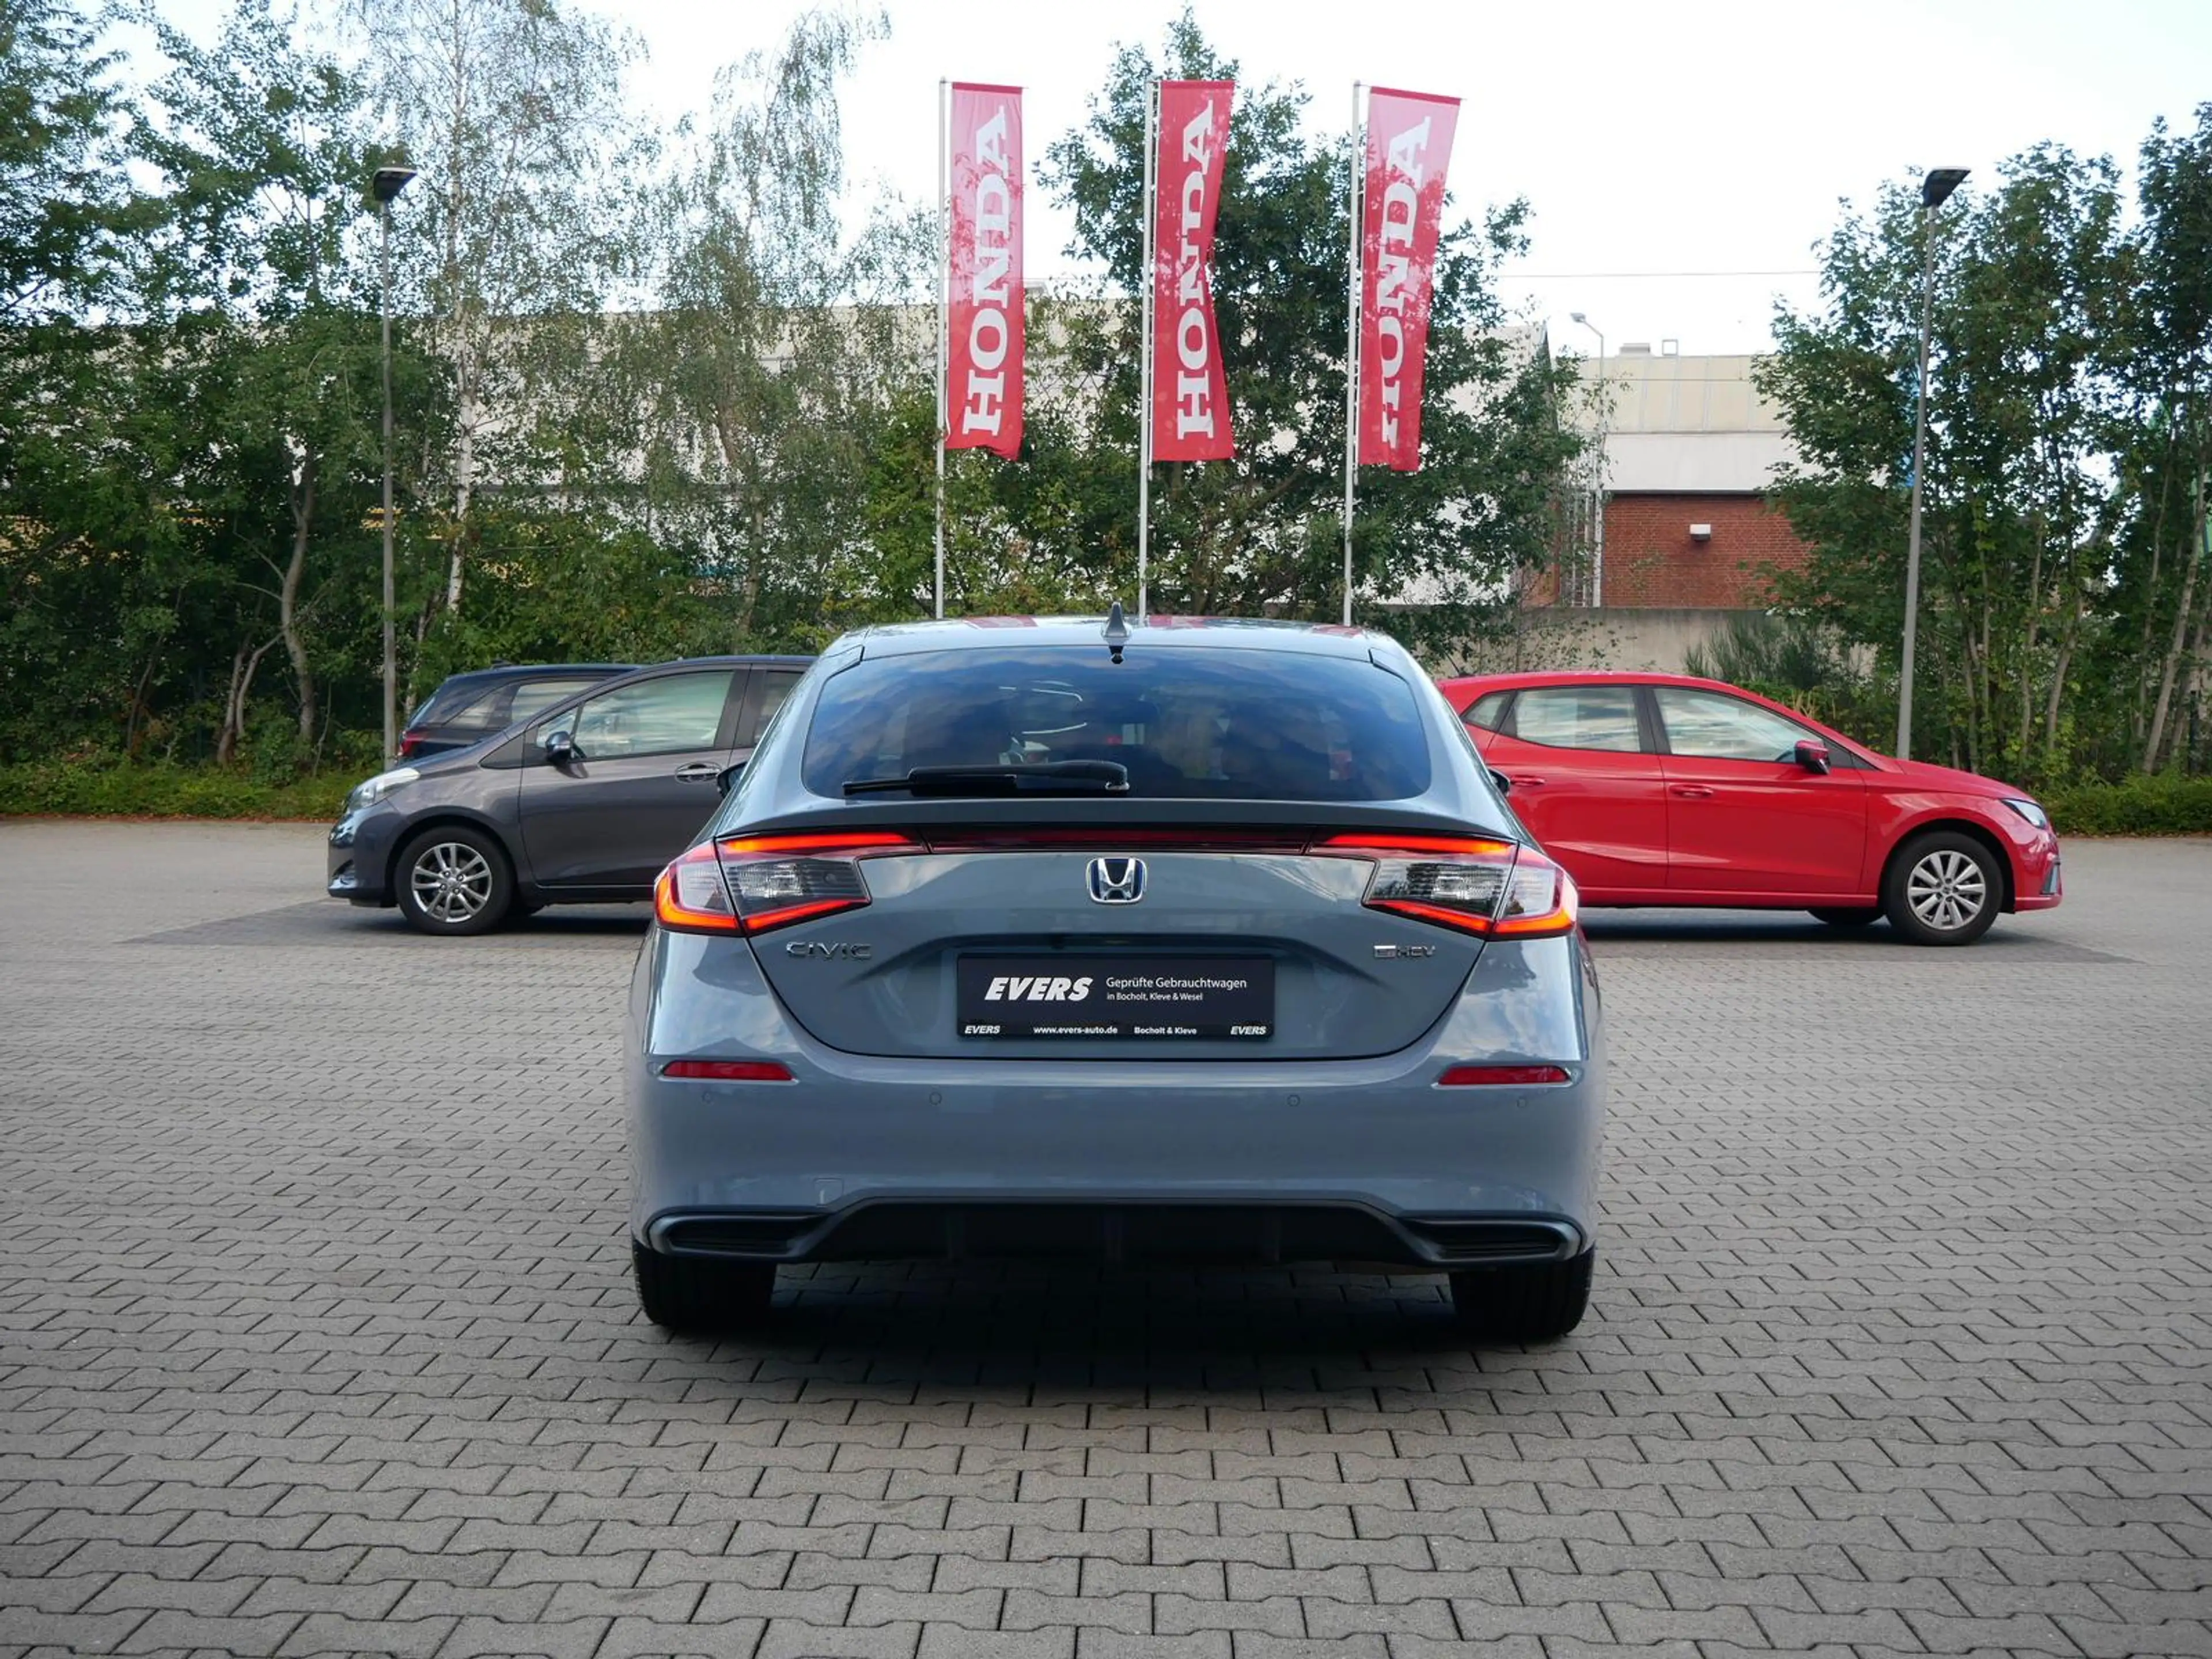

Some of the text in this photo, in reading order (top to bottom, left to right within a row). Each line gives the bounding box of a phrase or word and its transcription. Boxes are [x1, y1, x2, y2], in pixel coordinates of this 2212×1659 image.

[962, 105, 1010, 437] HONDA
[1177, 100, 1217, 440] HONDA
[786, 941, 872, 960] CIVIC
[984, 977, 1093, 1001] EVERS
[1106, 977, 1247, 991] Geprüfte Gebrauchtwagen
[1107, 992, 1203, 1001] in Bocholt, Kleve & Wesel
[964, 1025, 1001, 1034] EVERS
[1033, 1026, 1118, 1034] www.evers-auto.de
[1134, 1027, 1165, 1035] Bocholt
[1175, 1027, 1198, 1035] Kleve
[1230, 1026, 1267, 1035] EVERS
